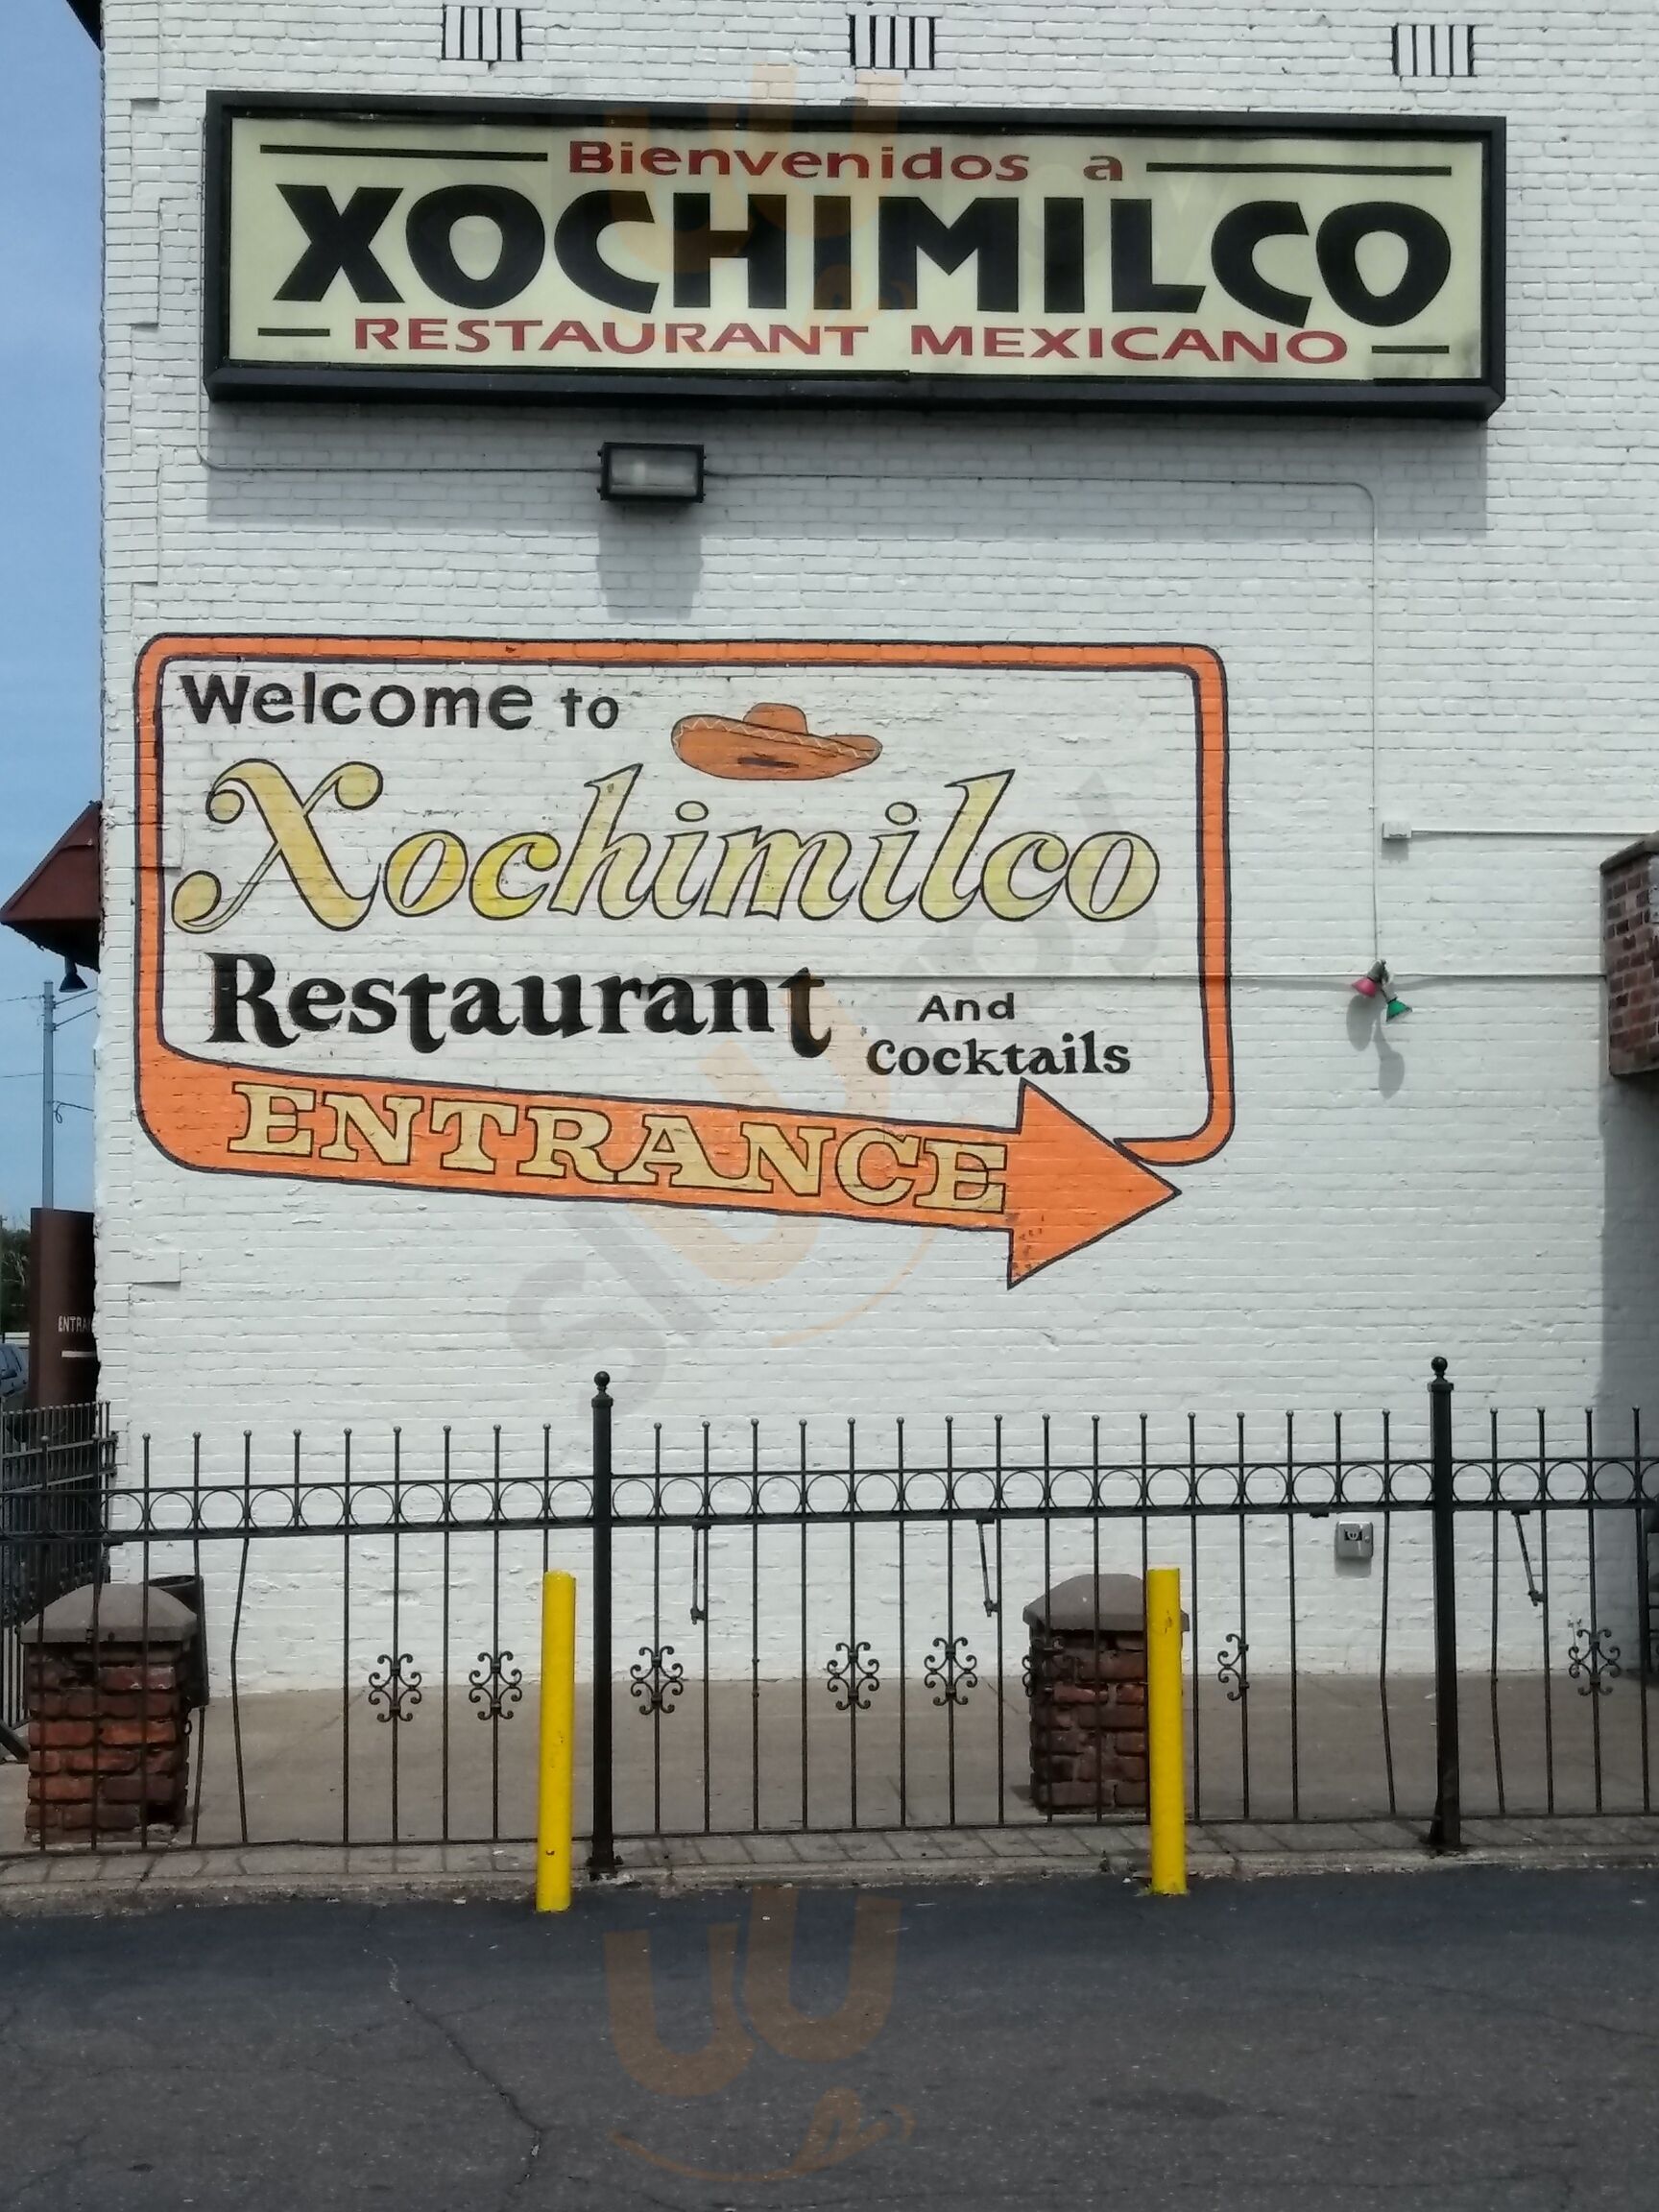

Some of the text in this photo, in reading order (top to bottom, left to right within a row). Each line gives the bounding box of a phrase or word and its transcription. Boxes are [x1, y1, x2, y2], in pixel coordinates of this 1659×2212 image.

[568, 140, 1123, 182] Bienvenidos a
[272, 183, 1452, 328] XOCHIMILCO
[353, 318, 1348, 364] RESTAURANT MEXICANO
[180, 672, 620, 731] Welcome to
[172, 757, 1160, 934] Xochimilco
[204, 951, 832, 1059] Restaurant
[917, 992, 1016, 1023] And
[866, 1030, 1132, 1077] Cocktails
[227, 1080, 1008, 1215] ENTRANCE
